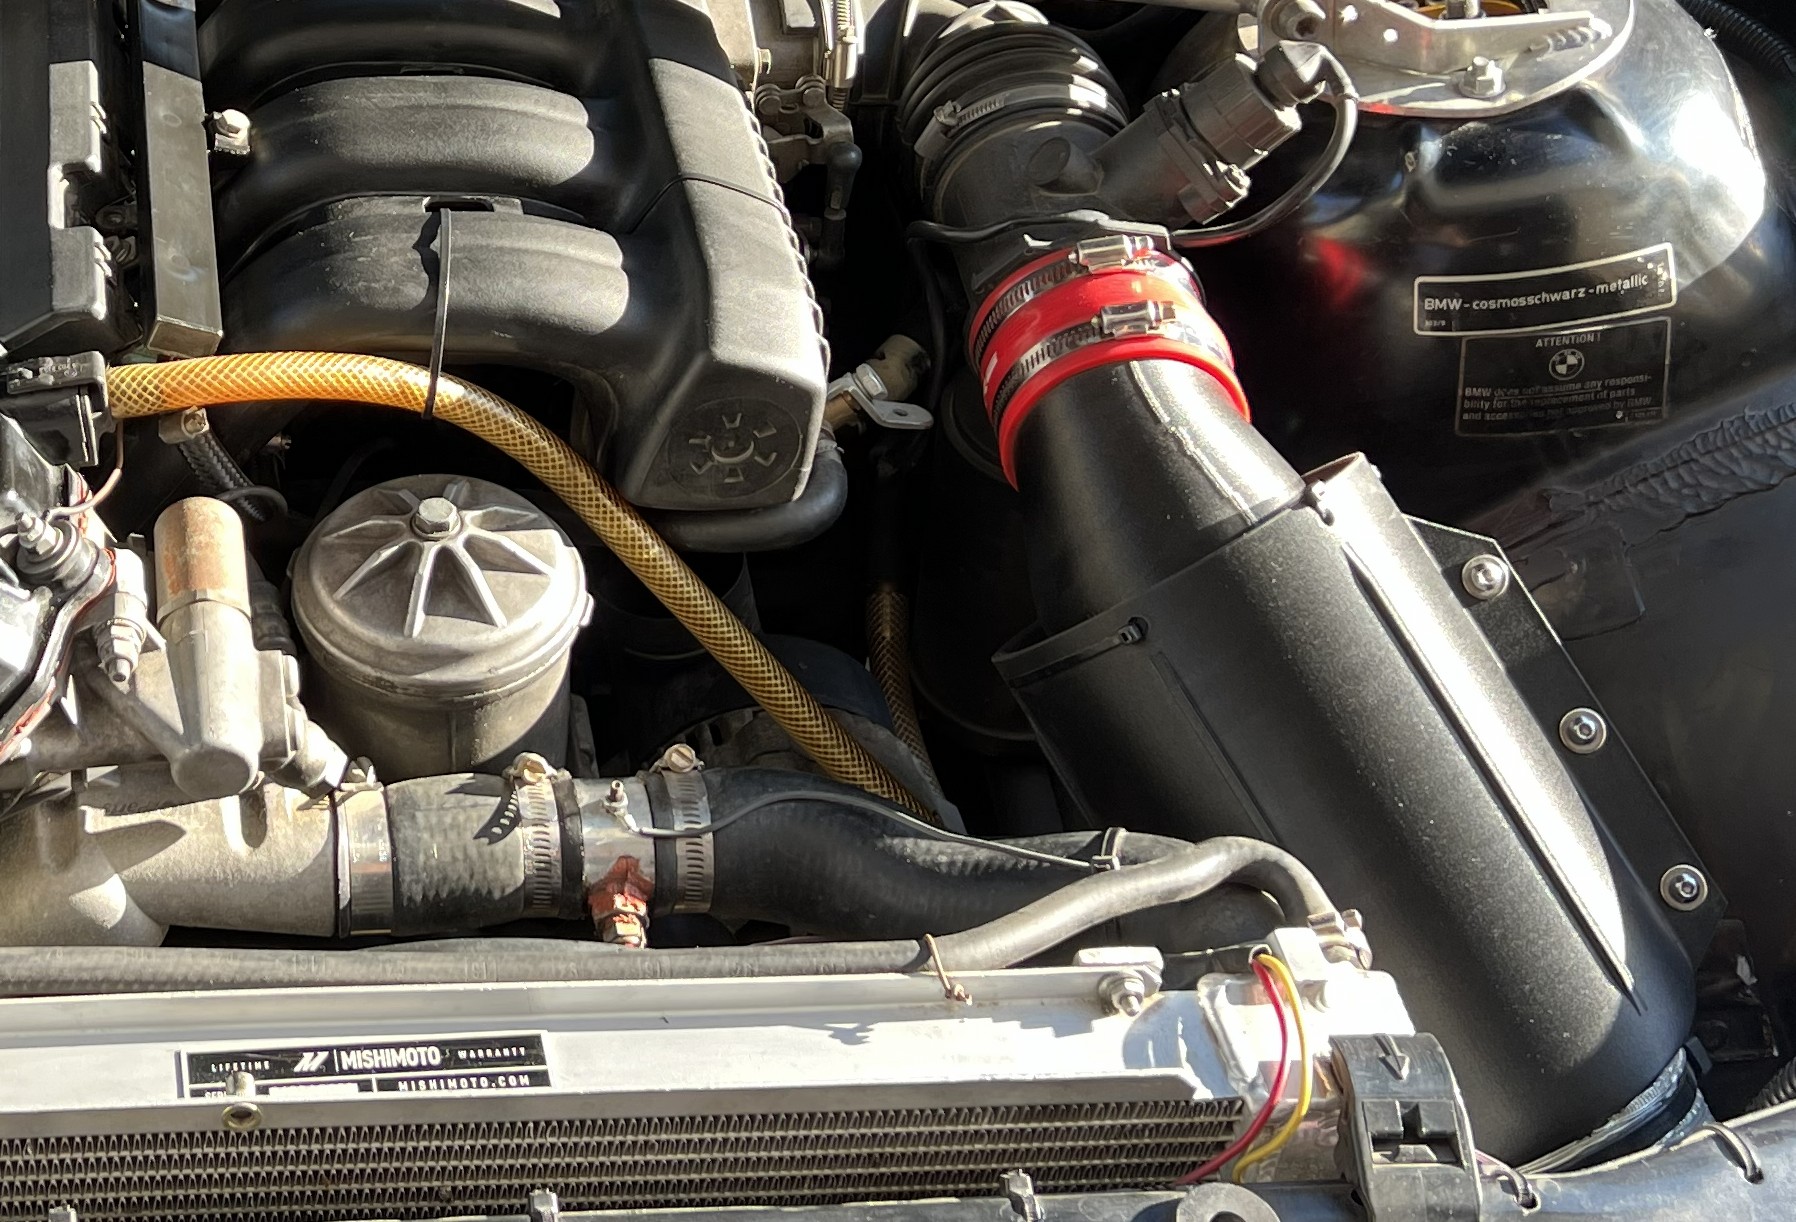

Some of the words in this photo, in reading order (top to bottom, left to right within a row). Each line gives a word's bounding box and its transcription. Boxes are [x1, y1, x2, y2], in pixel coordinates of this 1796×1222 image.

[1464, 387, 1492, 397] BMW
[1583, 380, 1603, 391] any
[1609, 387, 1636, 399] parts
[1462, 412, 1482, 420] and
[211, 1060, 270, 1073] LIFETIME
[340, 1046, 441, 1070] MISHIMOTO
[457, 1046, 525, 1060] WARRANTY
[397, 1074, 530, 1092] MISHIMOTO.COM
